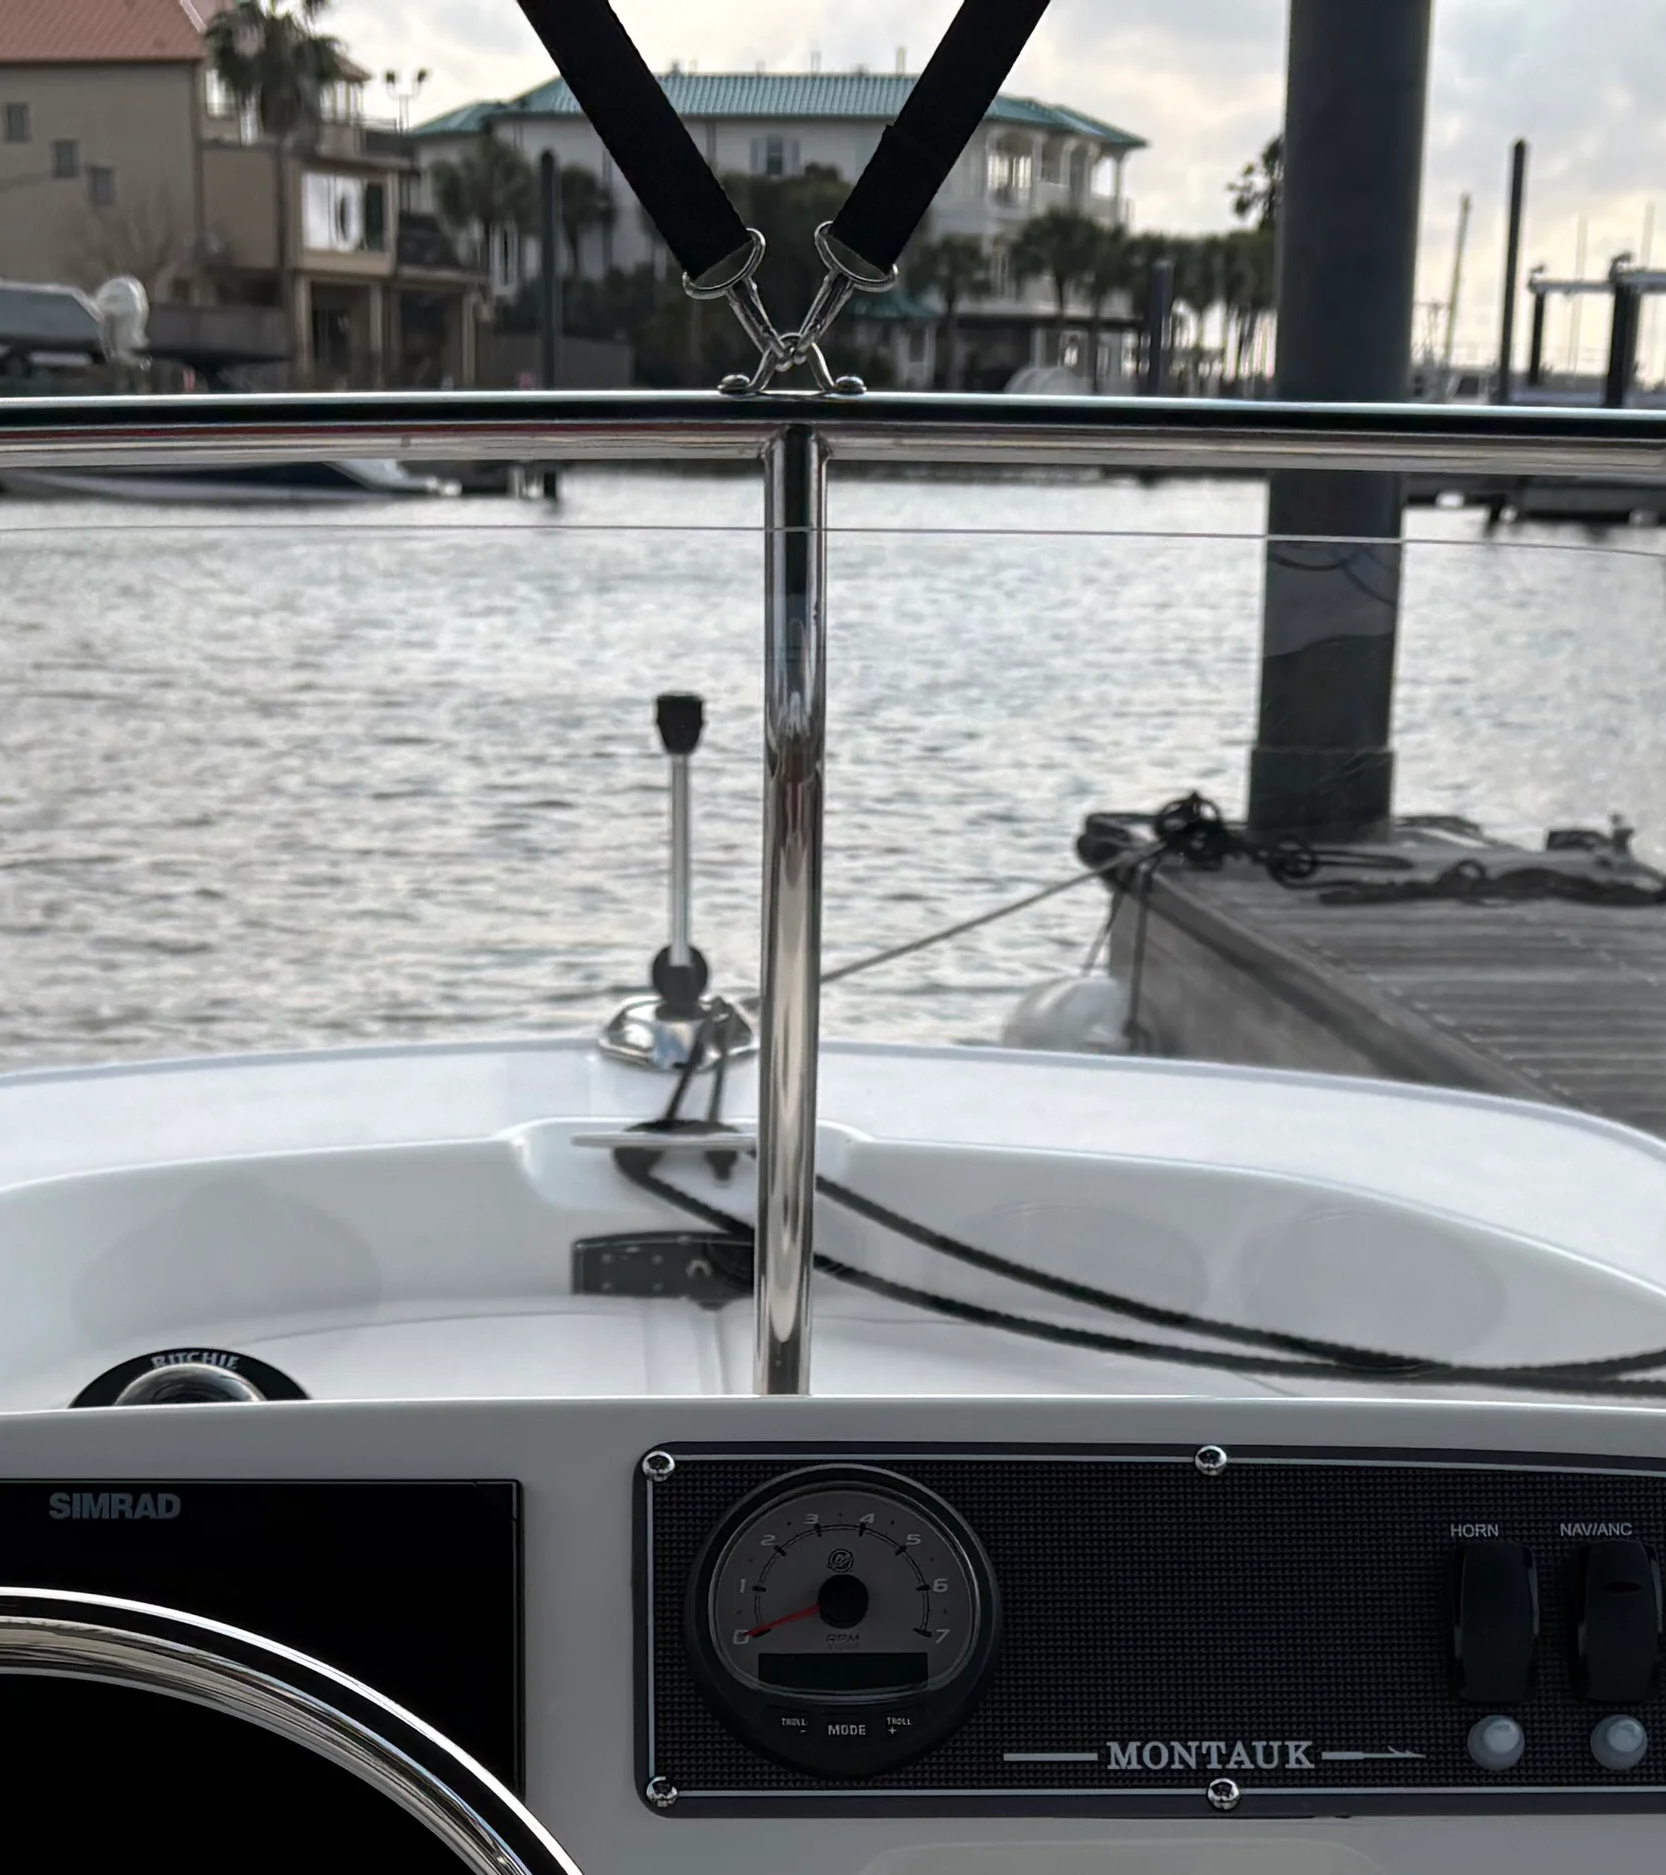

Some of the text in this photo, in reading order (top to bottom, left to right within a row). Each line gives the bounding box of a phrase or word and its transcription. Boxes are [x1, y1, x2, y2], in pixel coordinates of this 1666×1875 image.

[151, 1351, 241, 1370] RITCHIE
[49, 1492, 182, 1520] SIMRAD
[803, 1513, 819, 1524] 3
[859, 1513, 875, 1524] 4
[1451, 1523, 1499, 1538] HORN
[1559, 1523, 1633, 1537] NAV/ANC
[760, 1534, 776, 1545] 2
[905, 1534, 922, 1545] 5
[739, 1579, 746, 1594] 1
[933, 1578, 949, 1592] 6
[935, 1629, 951, 1644] 7
[827, 1723, 867, 1736] MODE
[1106, 1741, 1316, 1771] MONTAUK
